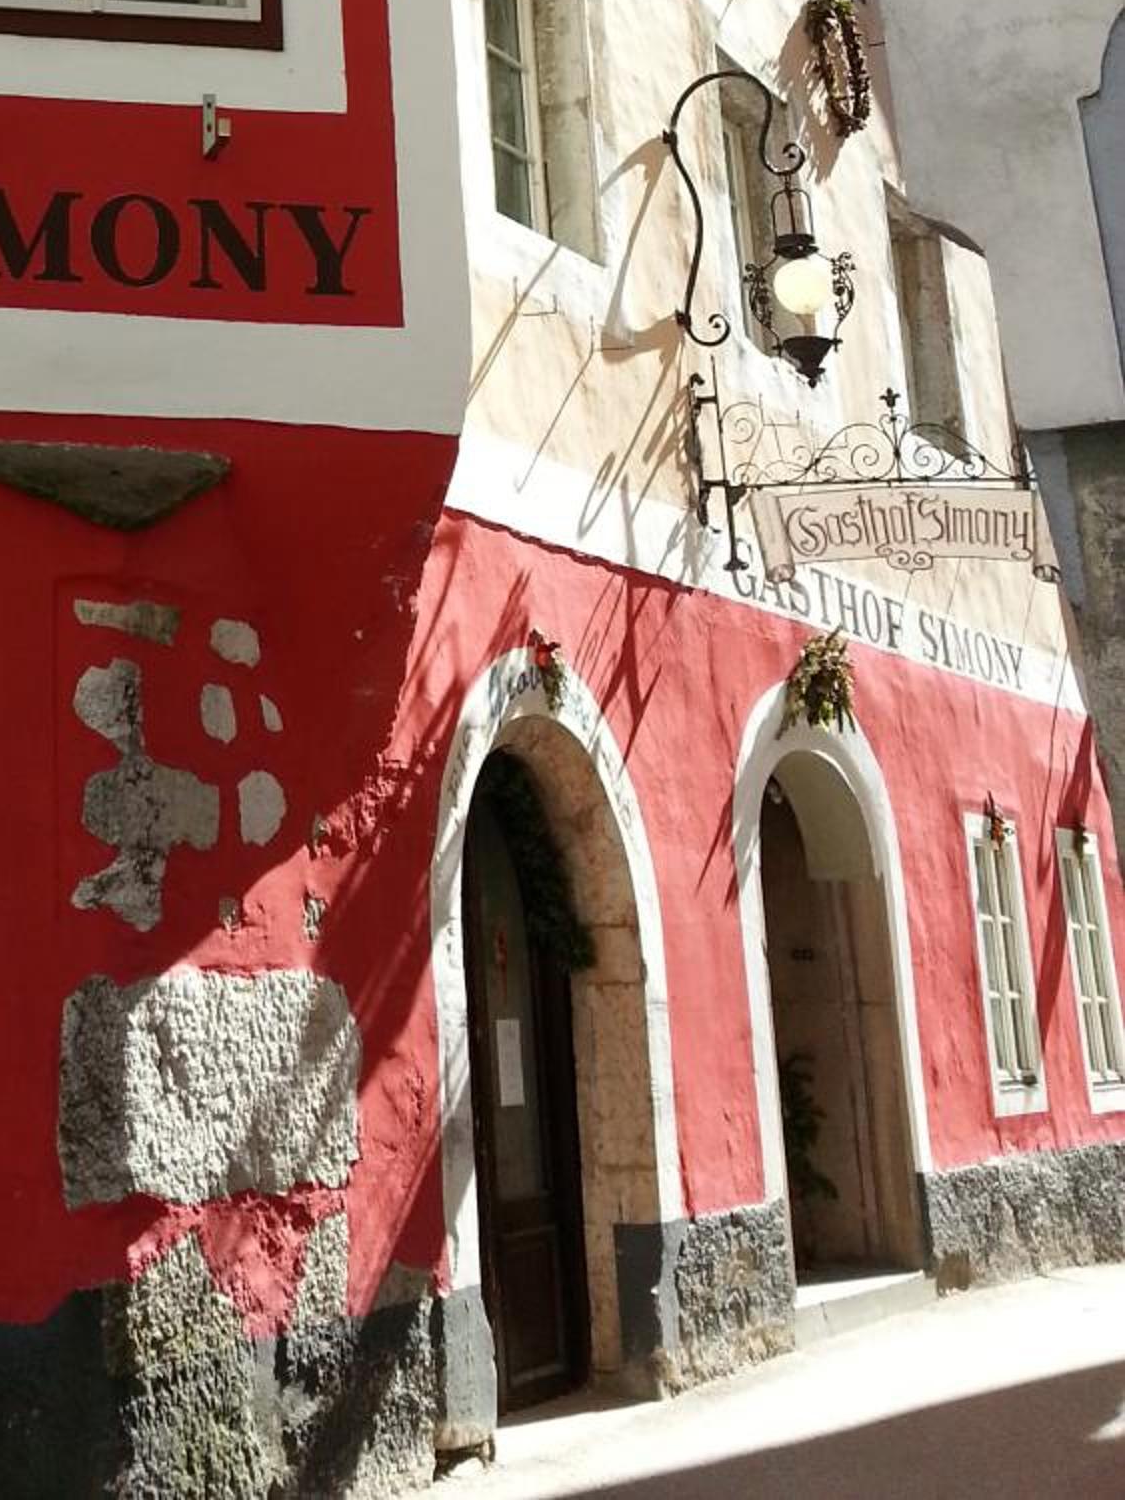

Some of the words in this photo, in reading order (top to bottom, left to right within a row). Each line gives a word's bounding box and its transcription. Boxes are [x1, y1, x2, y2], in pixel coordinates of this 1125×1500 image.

[787, 491, 917, 557] Gasthof
[916, 493, 1033, 562] Simony
[917, 608, 1024, 691] SIMONY
